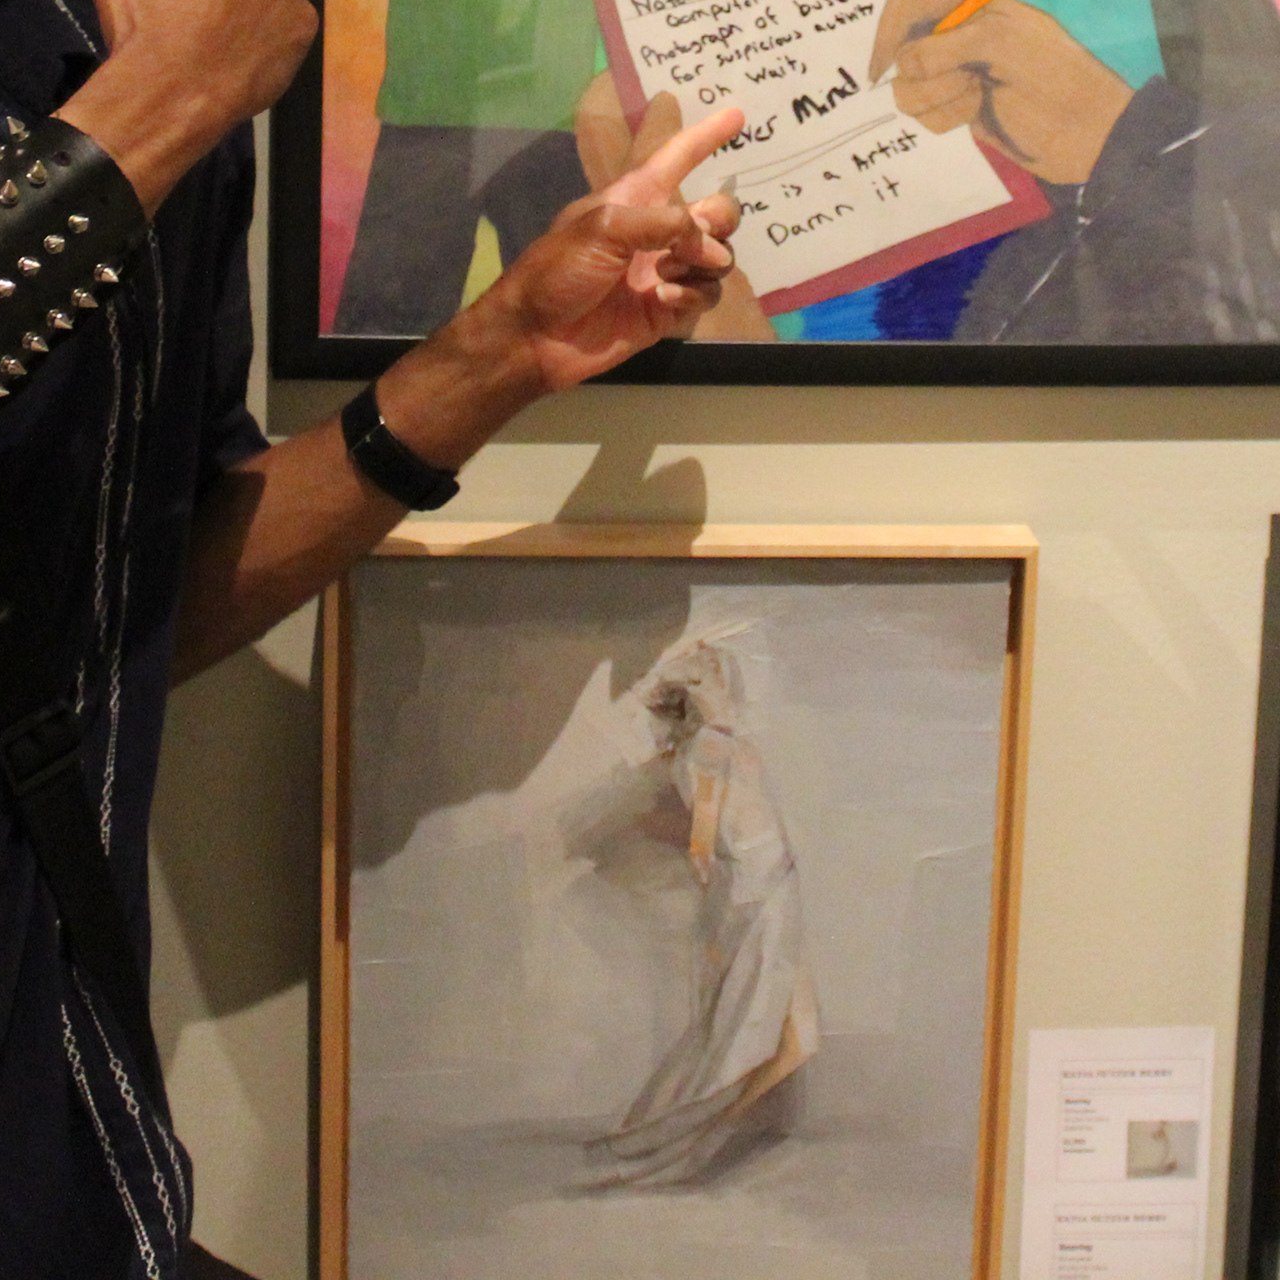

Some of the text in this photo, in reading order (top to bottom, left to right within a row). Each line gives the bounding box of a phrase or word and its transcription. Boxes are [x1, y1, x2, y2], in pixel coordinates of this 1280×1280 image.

[754, 5, 779, 30] of
[713, 66, 861, 158] ever Mind
[780, 183, 803, 199] is
[822, 170, 842, 182] a
[851, 129, 918, 173] Artist
[766, 174, 901, 247] Damn it
